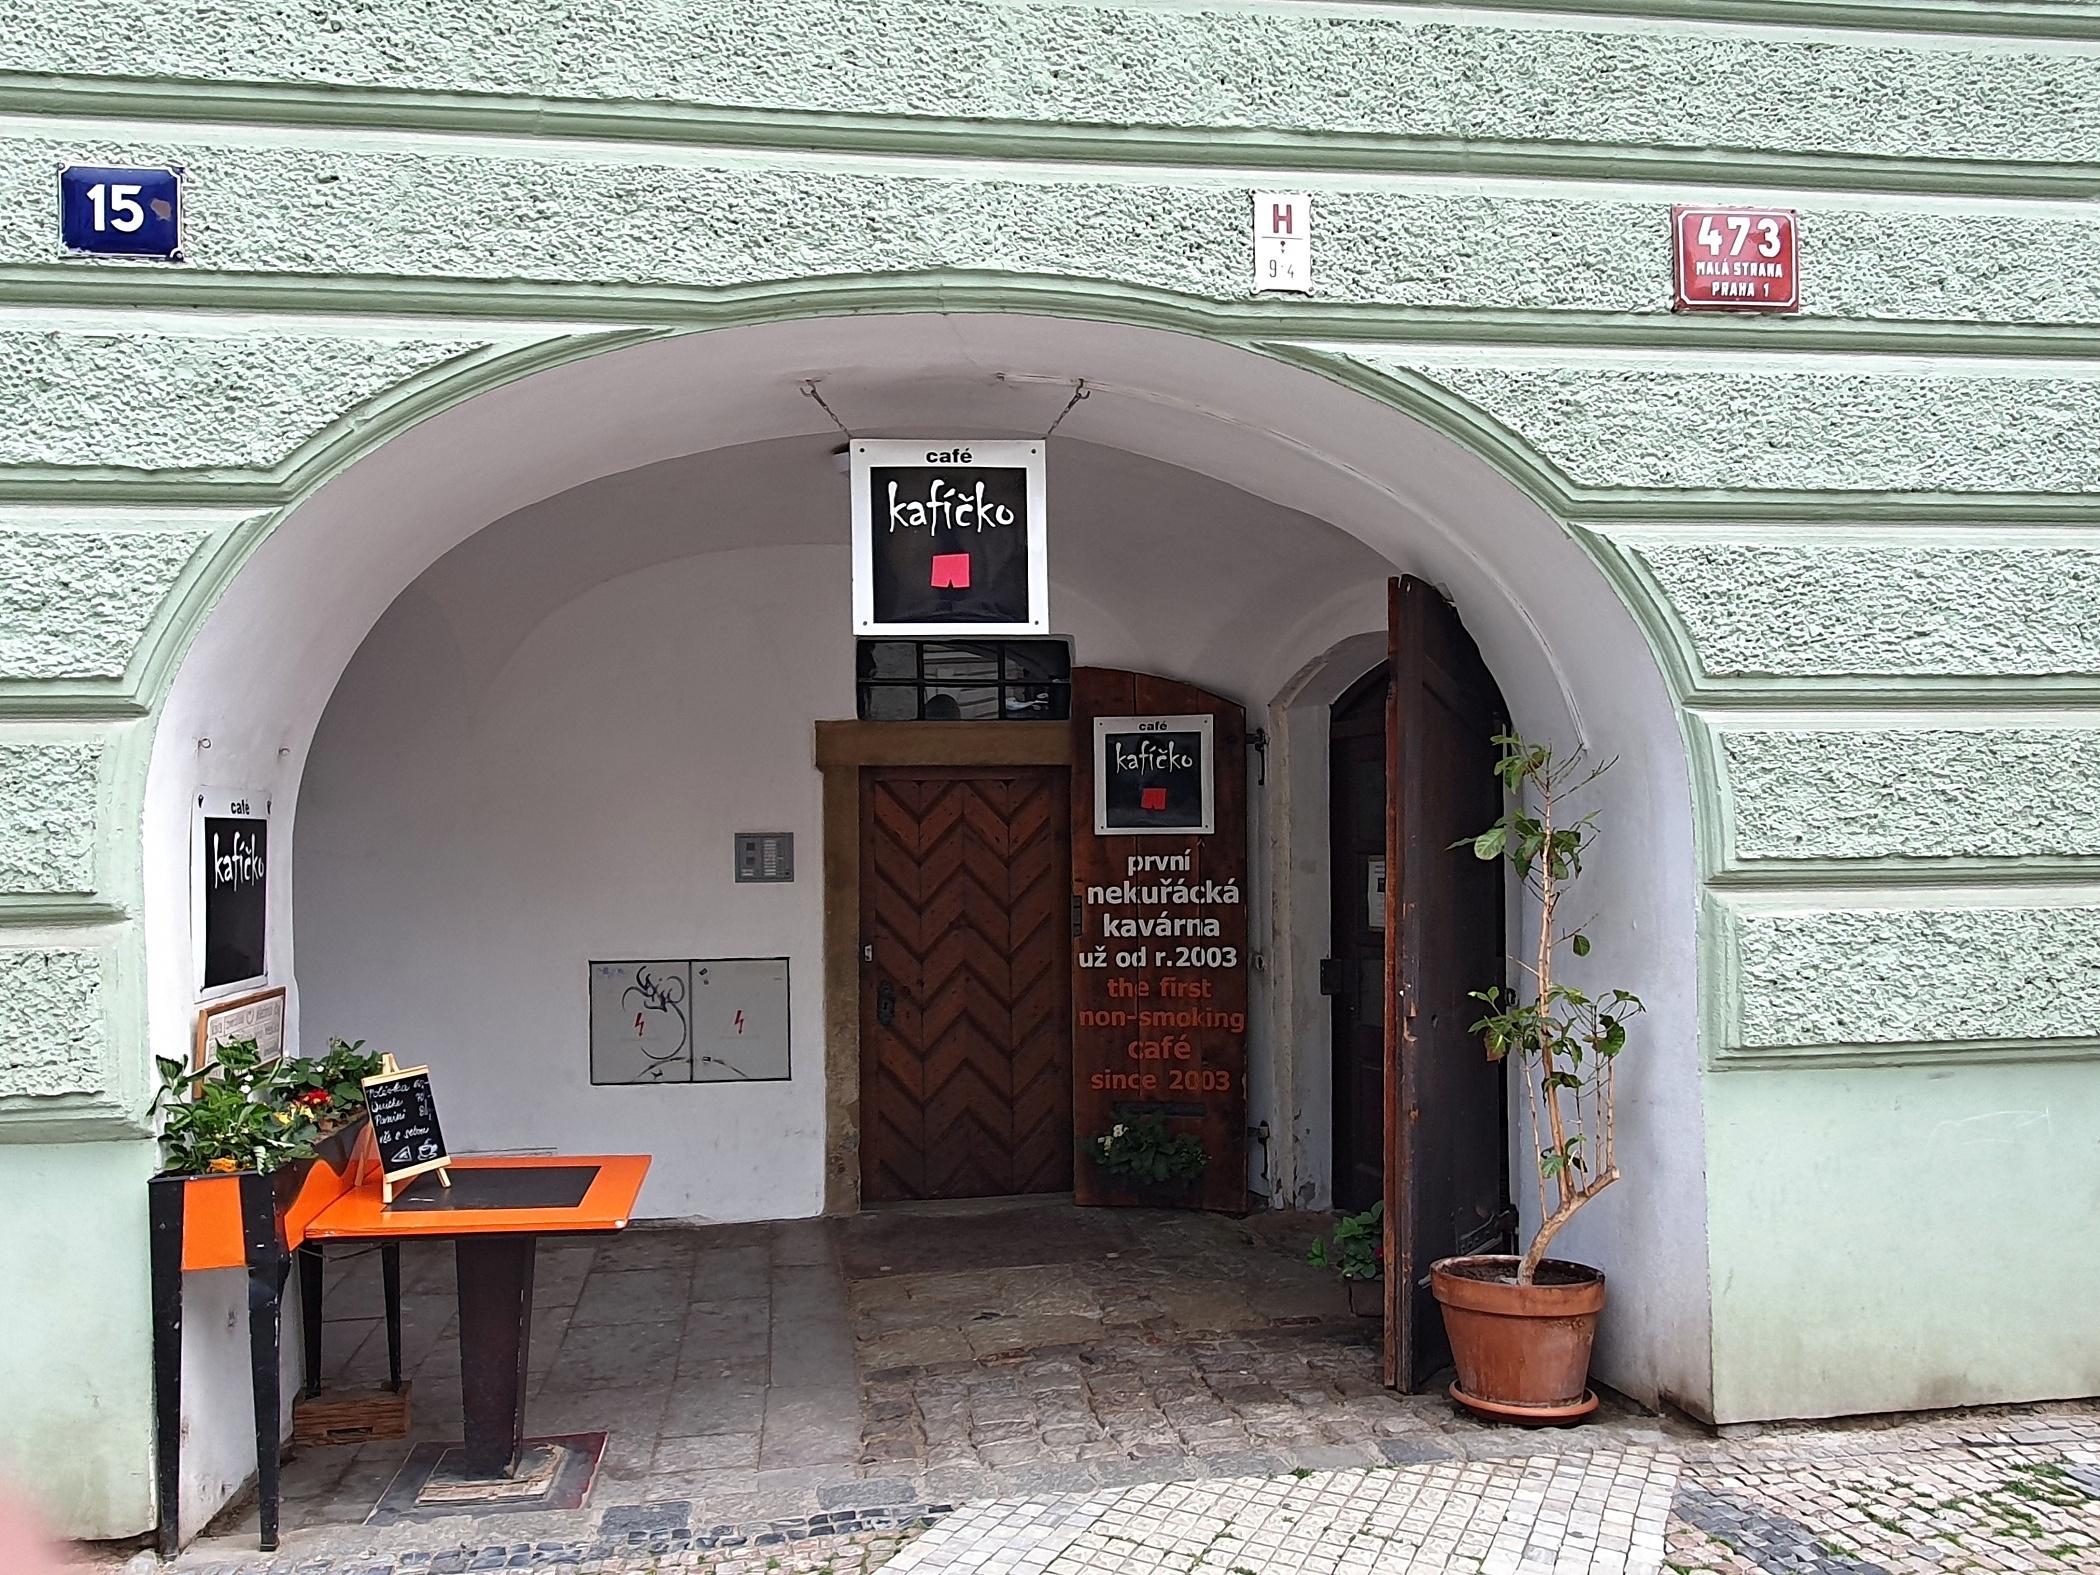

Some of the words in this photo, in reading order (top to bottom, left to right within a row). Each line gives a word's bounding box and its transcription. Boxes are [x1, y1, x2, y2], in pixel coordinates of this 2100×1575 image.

[87, 184, 144, 232] 15
[1273, 204, 1293, 234] H
[1698, 216, 1781, 258] 473
[1696, 258, 1729, 276] MALÁ
[1733, 262, 1783, 278] STRANA
[1712, 281, 1755, 297] PRAHA
[1763, 282, 1770, 297] 1
[926, 448, 973, 463] café
[887, 479, 1015, 536] kafíčko
[1138, 721, 1168, 731] café
[1115, 740, 1193, 775] kafíčko
[213, 831, 264, 891] kafíčko
[1128, 849, 1191, 877] první
[1087, 877, 1239, 904] nekuřácká
[1103, 911, 1220, 937] kavárna
[1079, 945, 1108, 968] už
[1115, 946, 1146, 967] od
[1107, 977, 1149, 998] the
[1160, 976, 1212, 998] first
[1079, 1007, 1245, 1033] non-smoking
[1128, 1034, 1191, 1060] café
[1091, 1068, 1157, 1090] since
[1168, 1070, 1230, 1091] 2003
[375, 1109, 406, 1126] Panini
